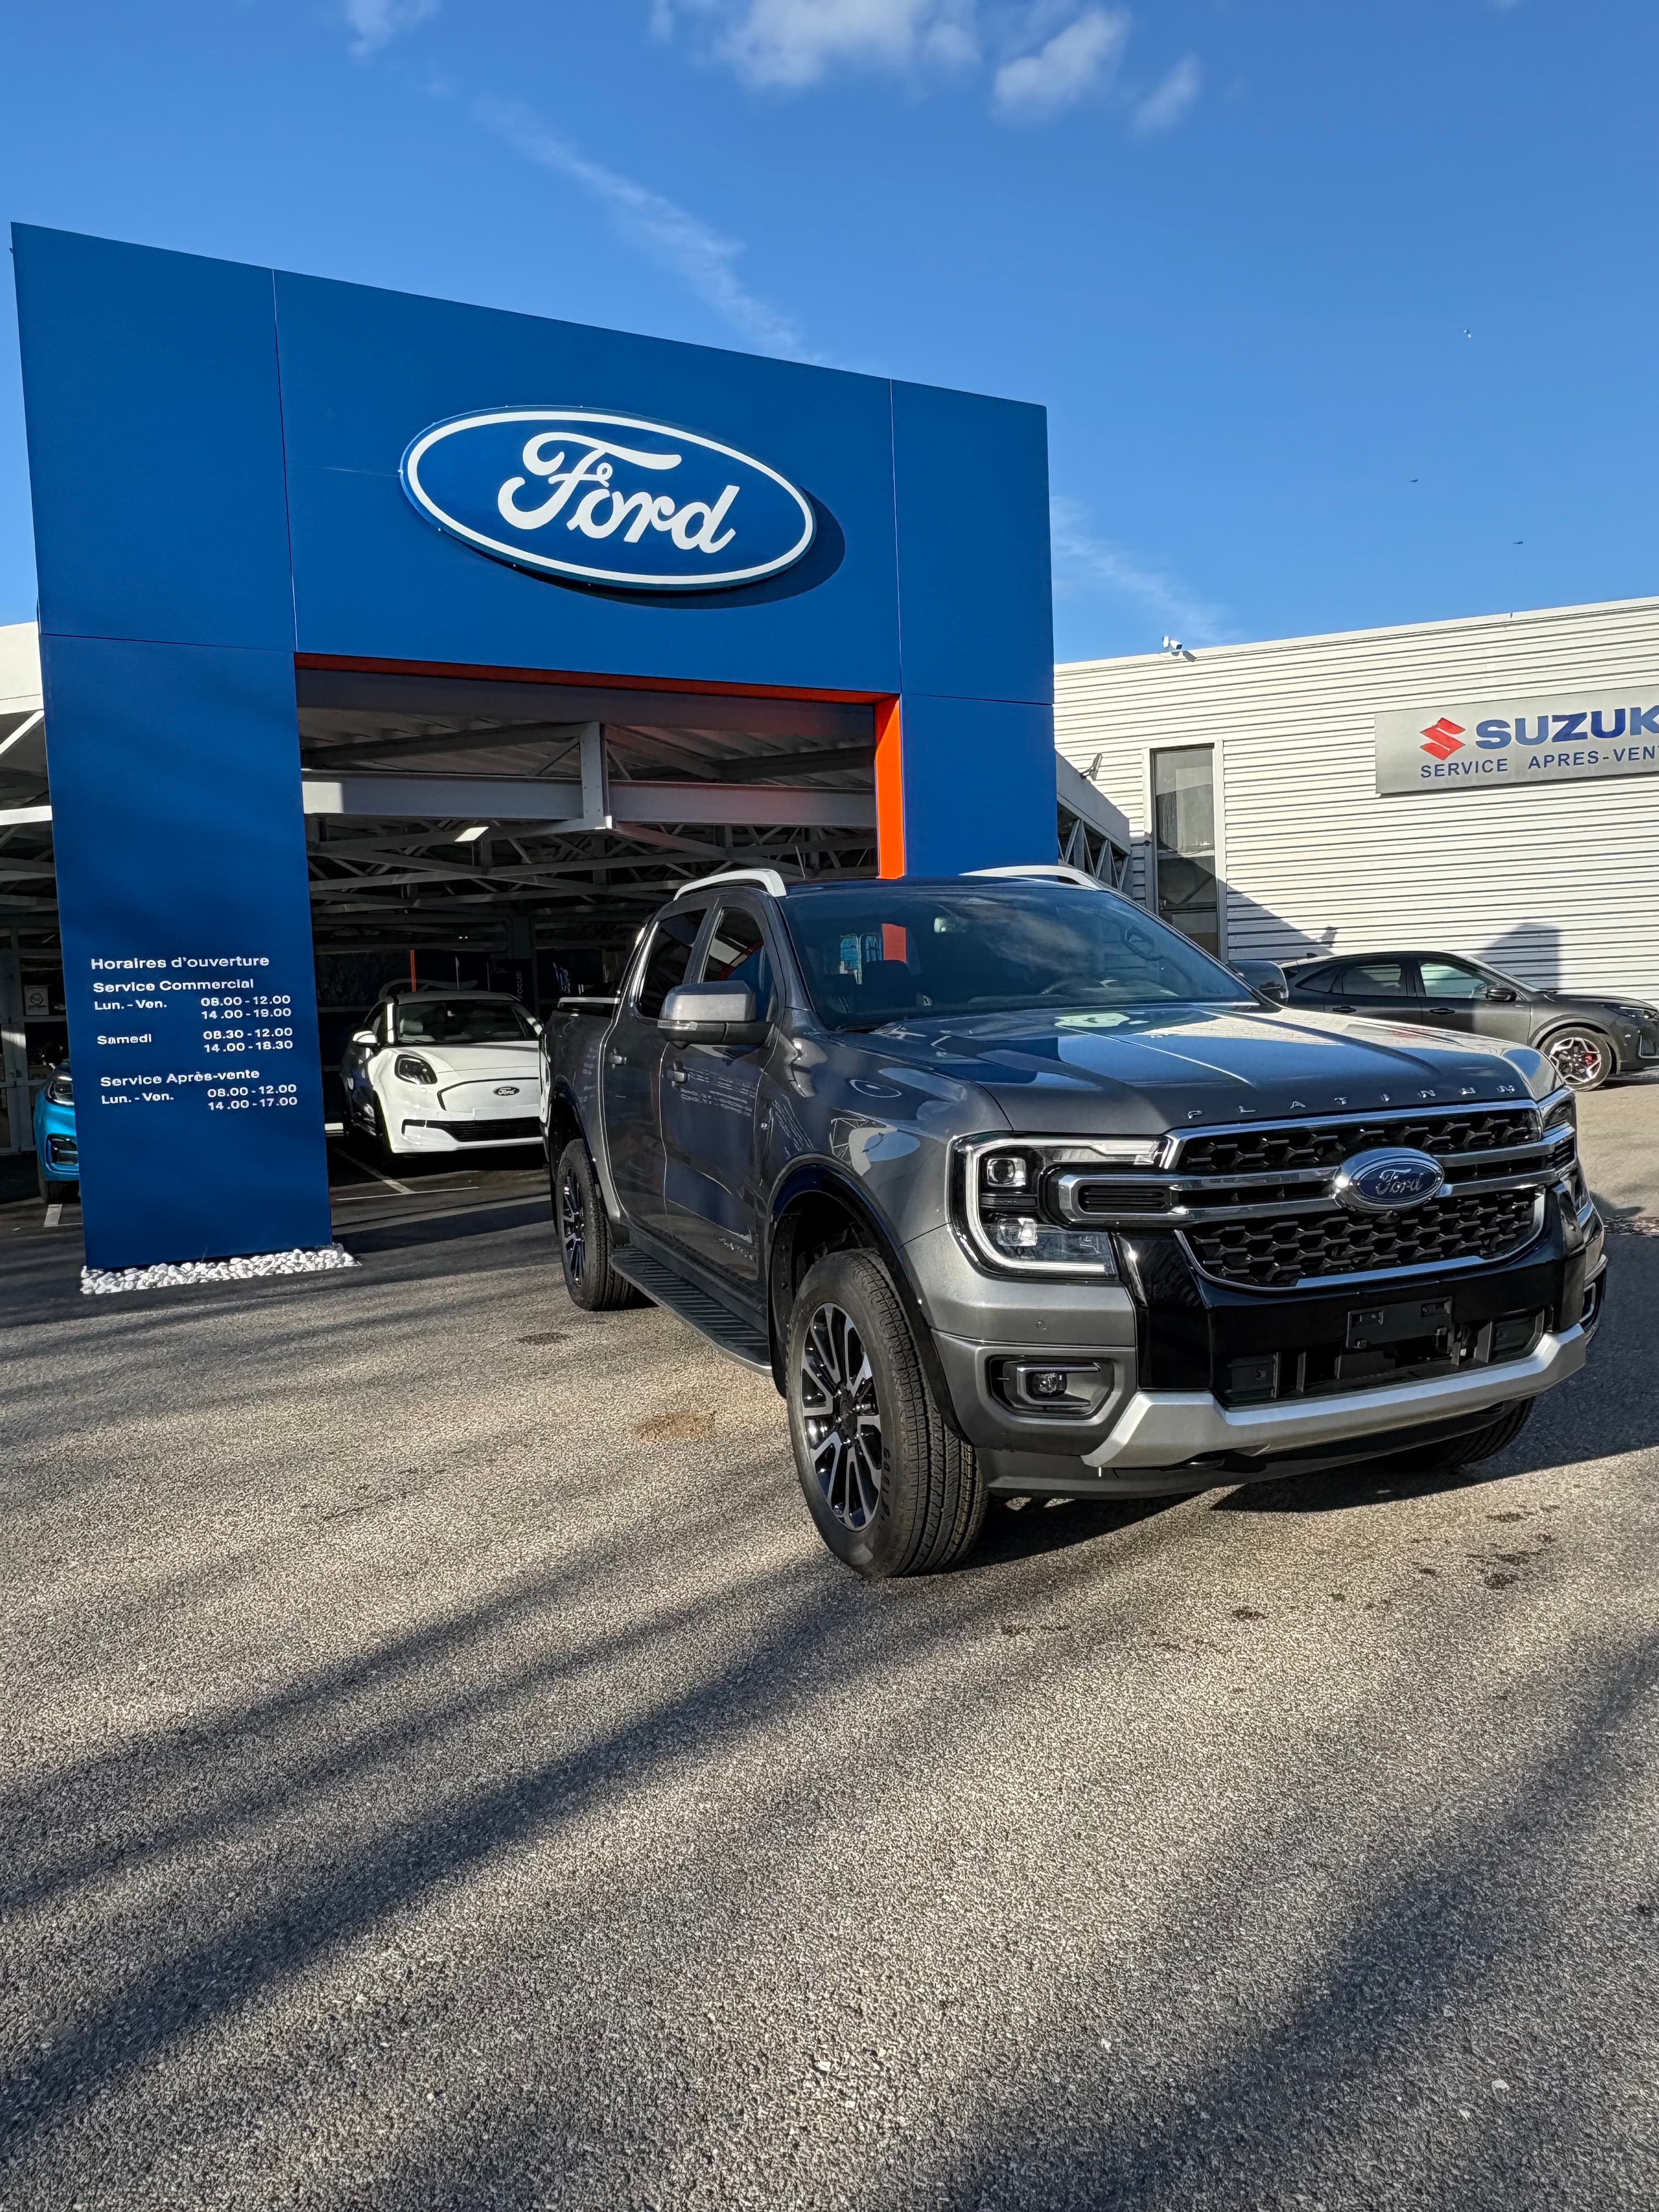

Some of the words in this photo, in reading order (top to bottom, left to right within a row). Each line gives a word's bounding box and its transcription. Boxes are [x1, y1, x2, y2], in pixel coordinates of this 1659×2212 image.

[497, 432, 740, 554] Ford
[1475, 705, 1659, 749] SUZUK
[1420, 758, 1508, 778] SERVICE
[1528, 744, 1659, 769] APRES-VEN
[91, 957, 167, 970] Horaires
[171, 956, 270, 968] d'ouverture
[93, 981, 155, 993] Service
[159, 978, 254, 991] Commercial
[94, 1001, 125, 1011] Lun.
[136, 999, 167, 1009] Ven.
[201, 996, 242, 1007] 08.00
[253, 995, 291, 1005] 12.00
[97, 1033, 152, 1045] Samedi
[203, 1029, 244, 1040] 08.30
[255, 1027, 293, 1037] 12.00
[256, 1040, 294, 1050] 18.30
[100, 1075, 162, 1087] Service
[166, 1070, 260, 1085] Après-vente
[101, 1095, 132, 1104] Lun.
[142, 1092, 174, 1102] Ven.
[207, 1087, 249, 1098] 08.00
[258, 1084, 297, 1094] 12.00
[259, 1097, 298, 1107] 17.00
[1375, 1168, 1425, 1195] Ford
